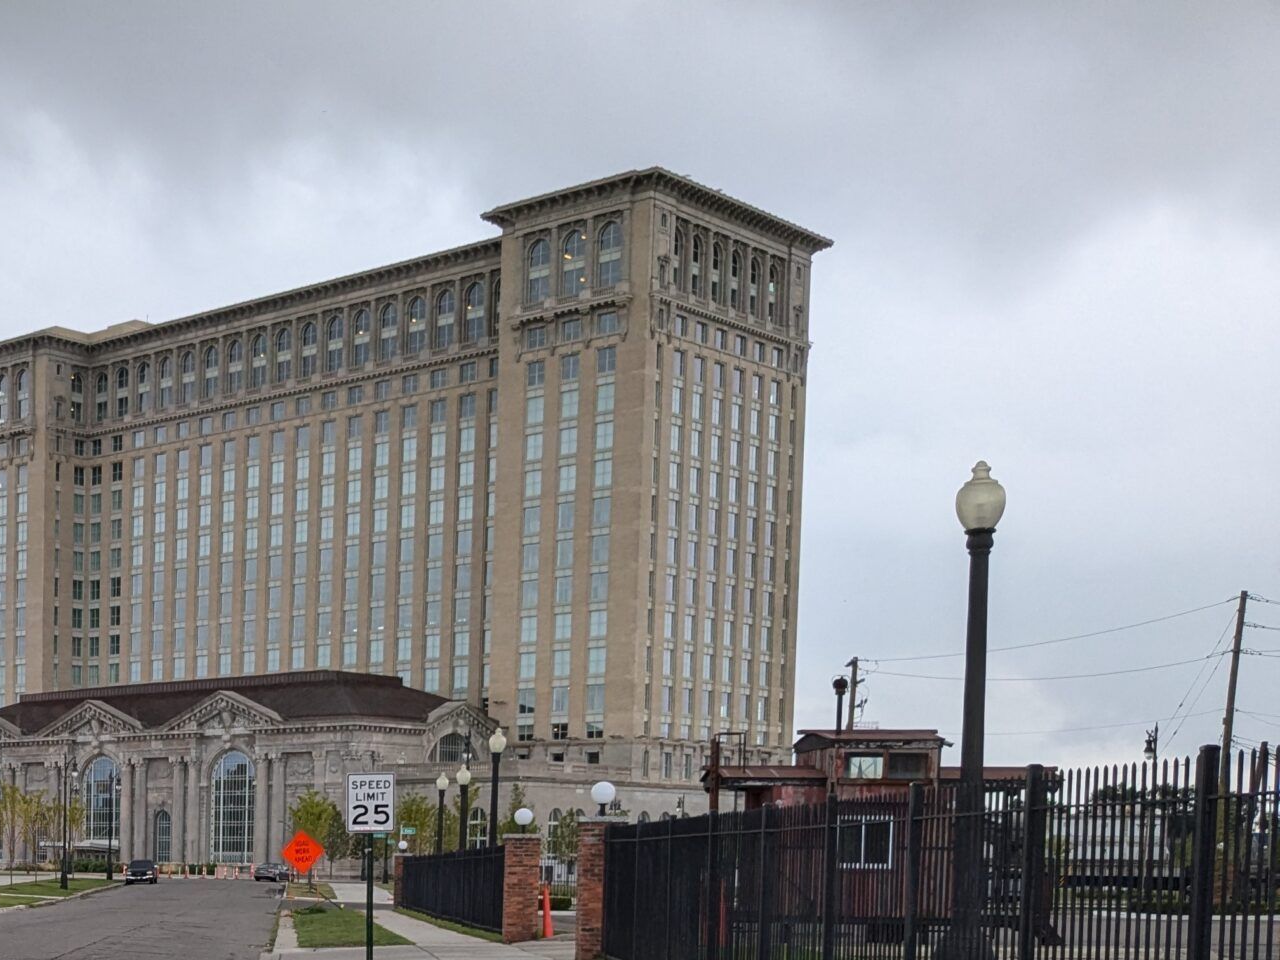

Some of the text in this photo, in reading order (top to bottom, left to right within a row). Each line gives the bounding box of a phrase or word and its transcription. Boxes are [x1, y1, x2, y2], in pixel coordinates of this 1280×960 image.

[351, 780, 391, 790] SPEED
[355, 792, 387, 801] LIMIT
[352, 804, 390, 825] 25
